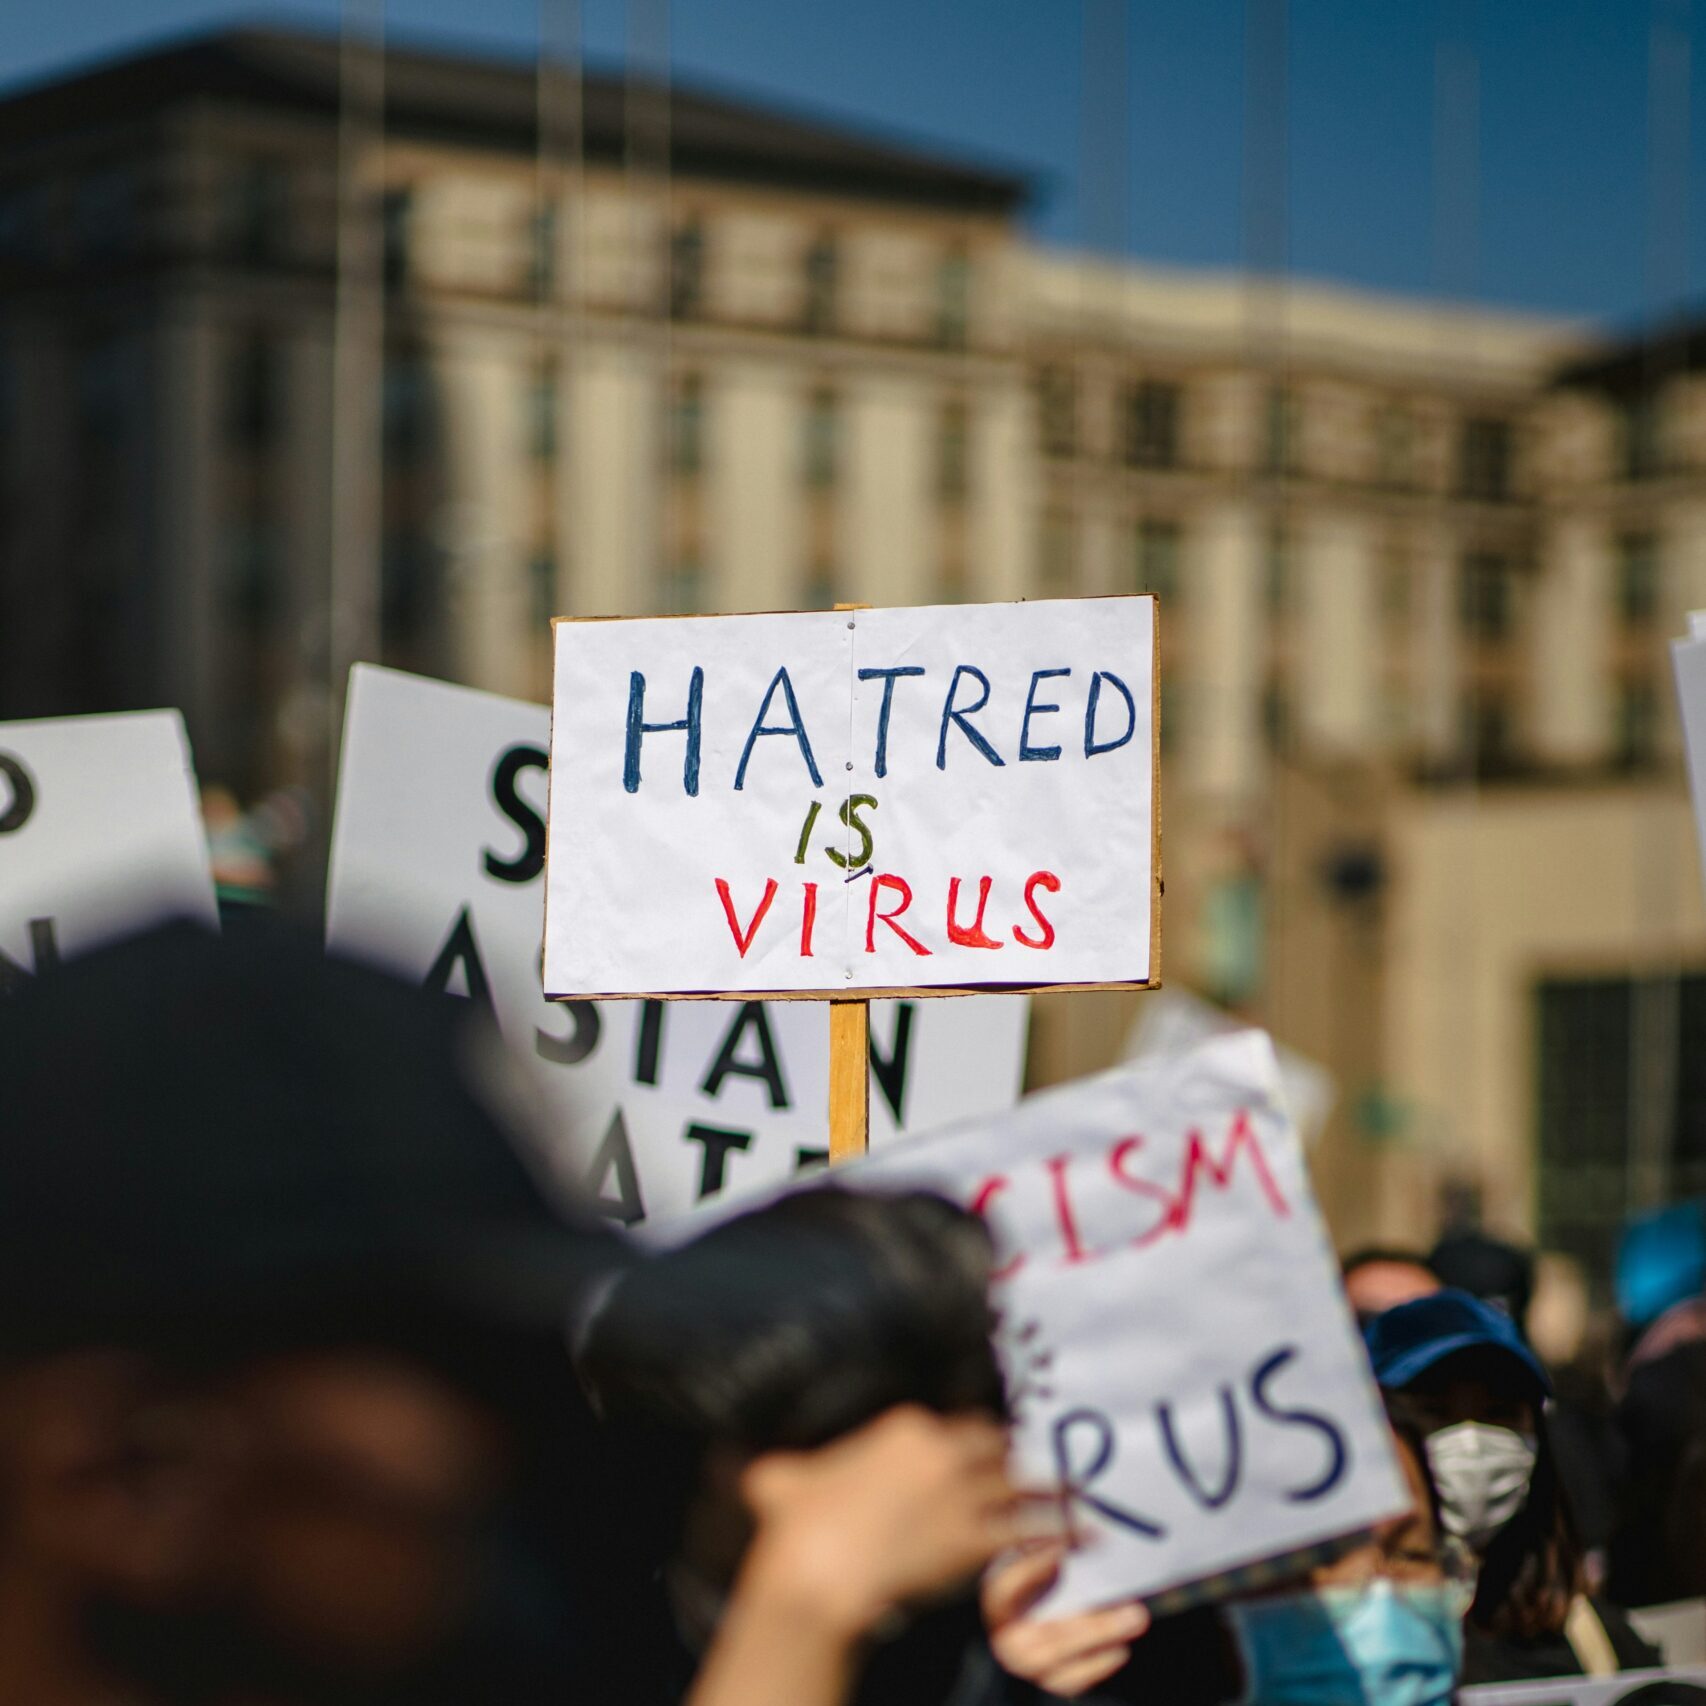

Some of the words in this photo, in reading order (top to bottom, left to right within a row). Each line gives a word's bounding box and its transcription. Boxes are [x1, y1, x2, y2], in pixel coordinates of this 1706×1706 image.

[622, 665, 1137, 797] HATRED
[793, 793, 879, 869] IS
[714, 870, 1062, 958] VIRUS
[966, 1107, 1291, 1282] CISM
[1051, 1343, 1351, 1552] RUS
